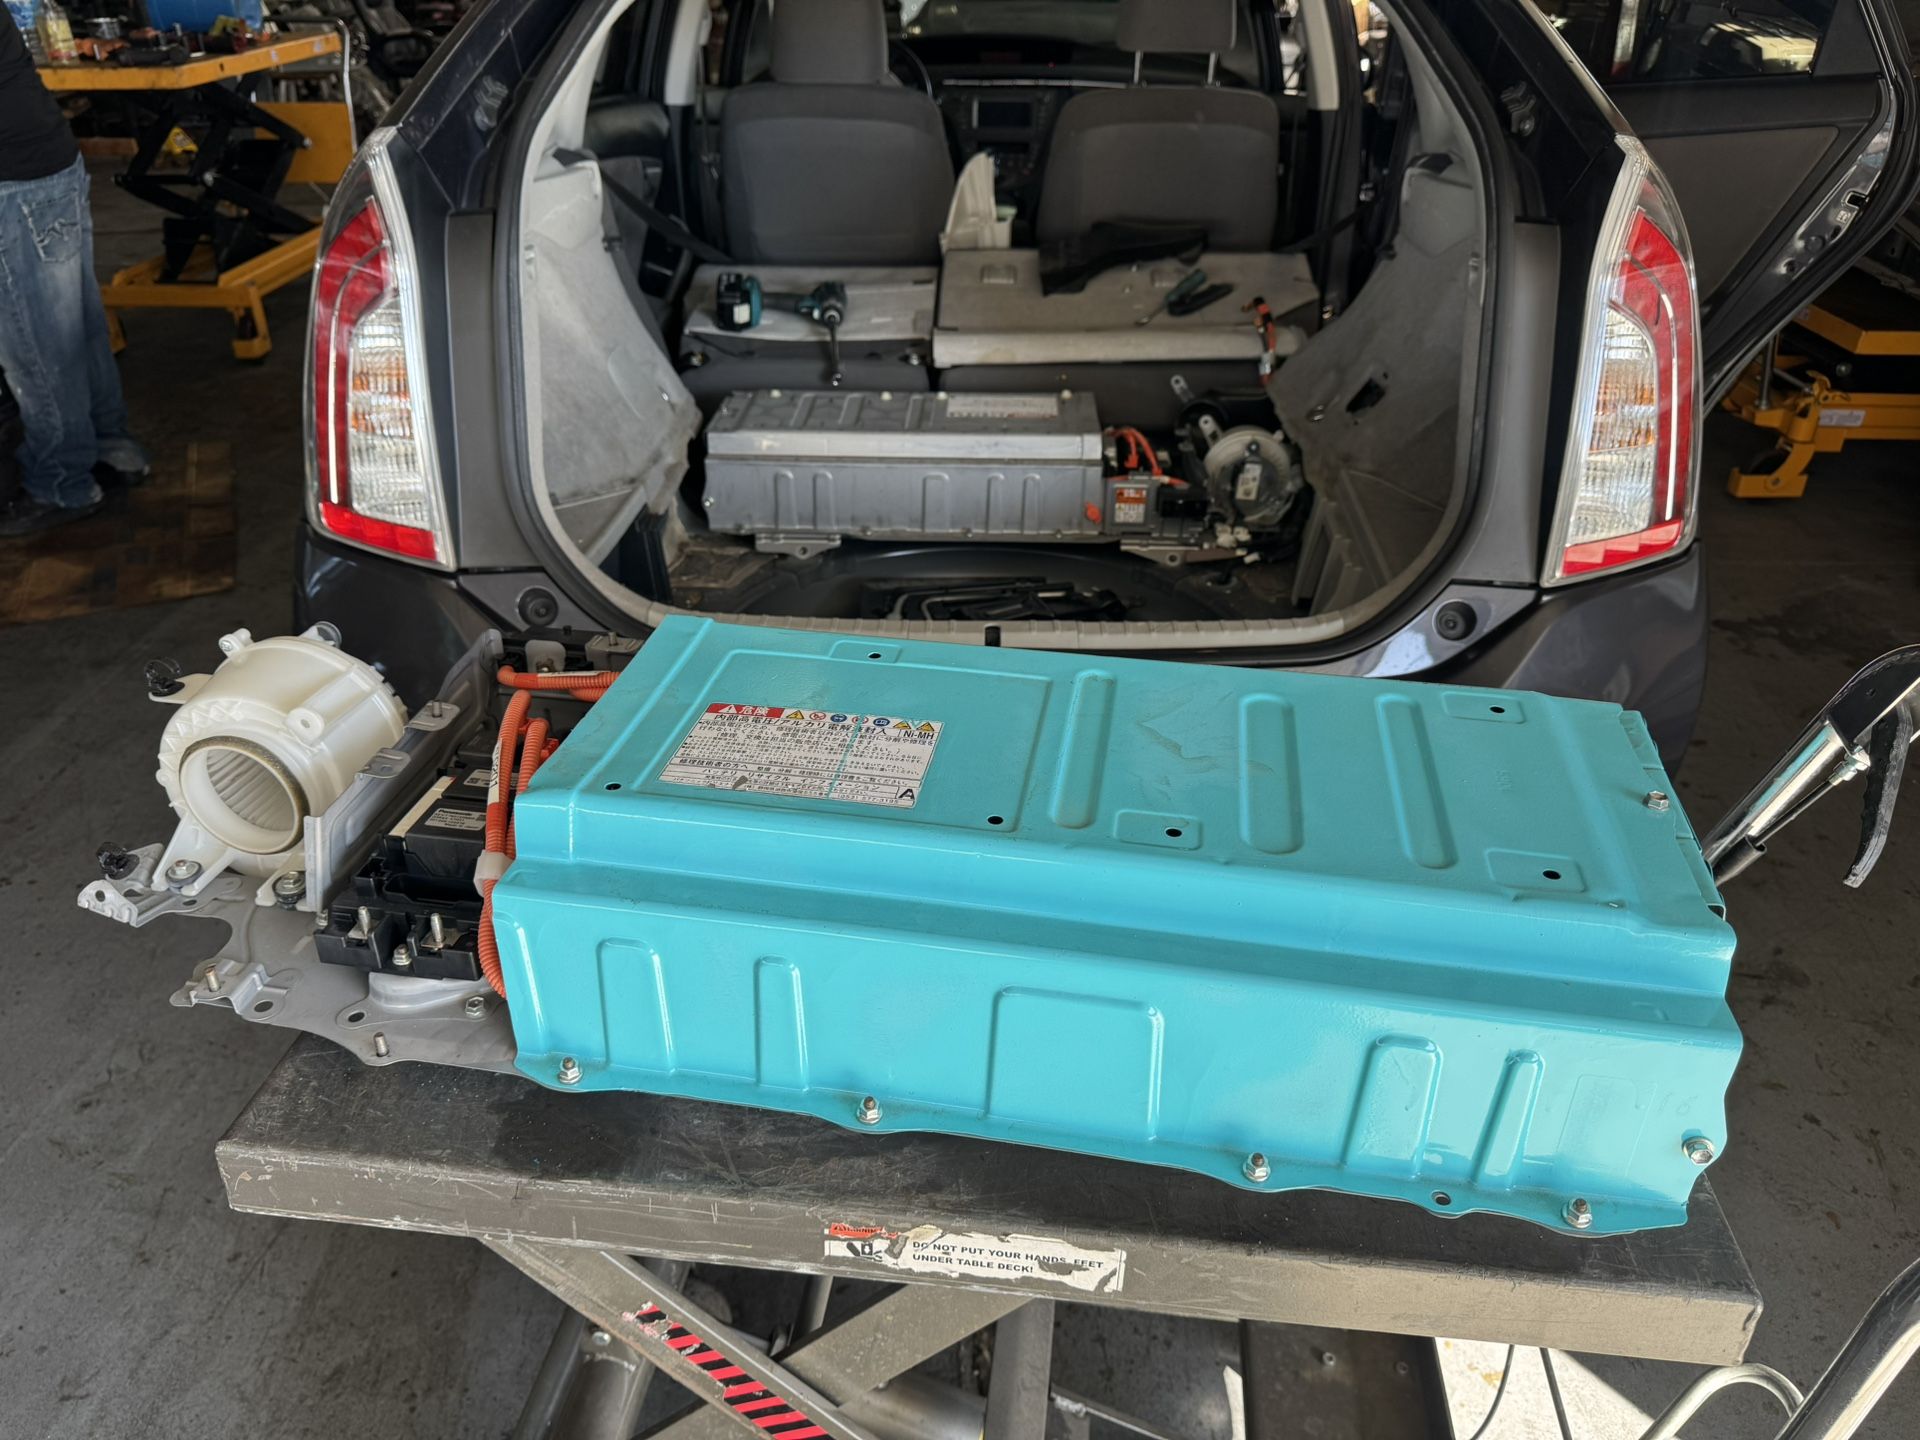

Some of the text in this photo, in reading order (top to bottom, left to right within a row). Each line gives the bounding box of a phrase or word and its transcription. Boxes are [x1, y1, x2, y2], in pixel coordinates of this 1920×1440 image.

[739, 706, 768, 716] 危険
[903, 731, 934, 740] Ni-MH
[898, 788, 915, 800] A
[932, 1243, 957, 1253] NOT
[961, 1246, 985, 1256] PUT
[988, 1249, 1021, 1260] YOUR
[1073, 1258, 1104, 1269] FEET
[912, 1254, 1034, 1273] UNDER TABLE DECK!
